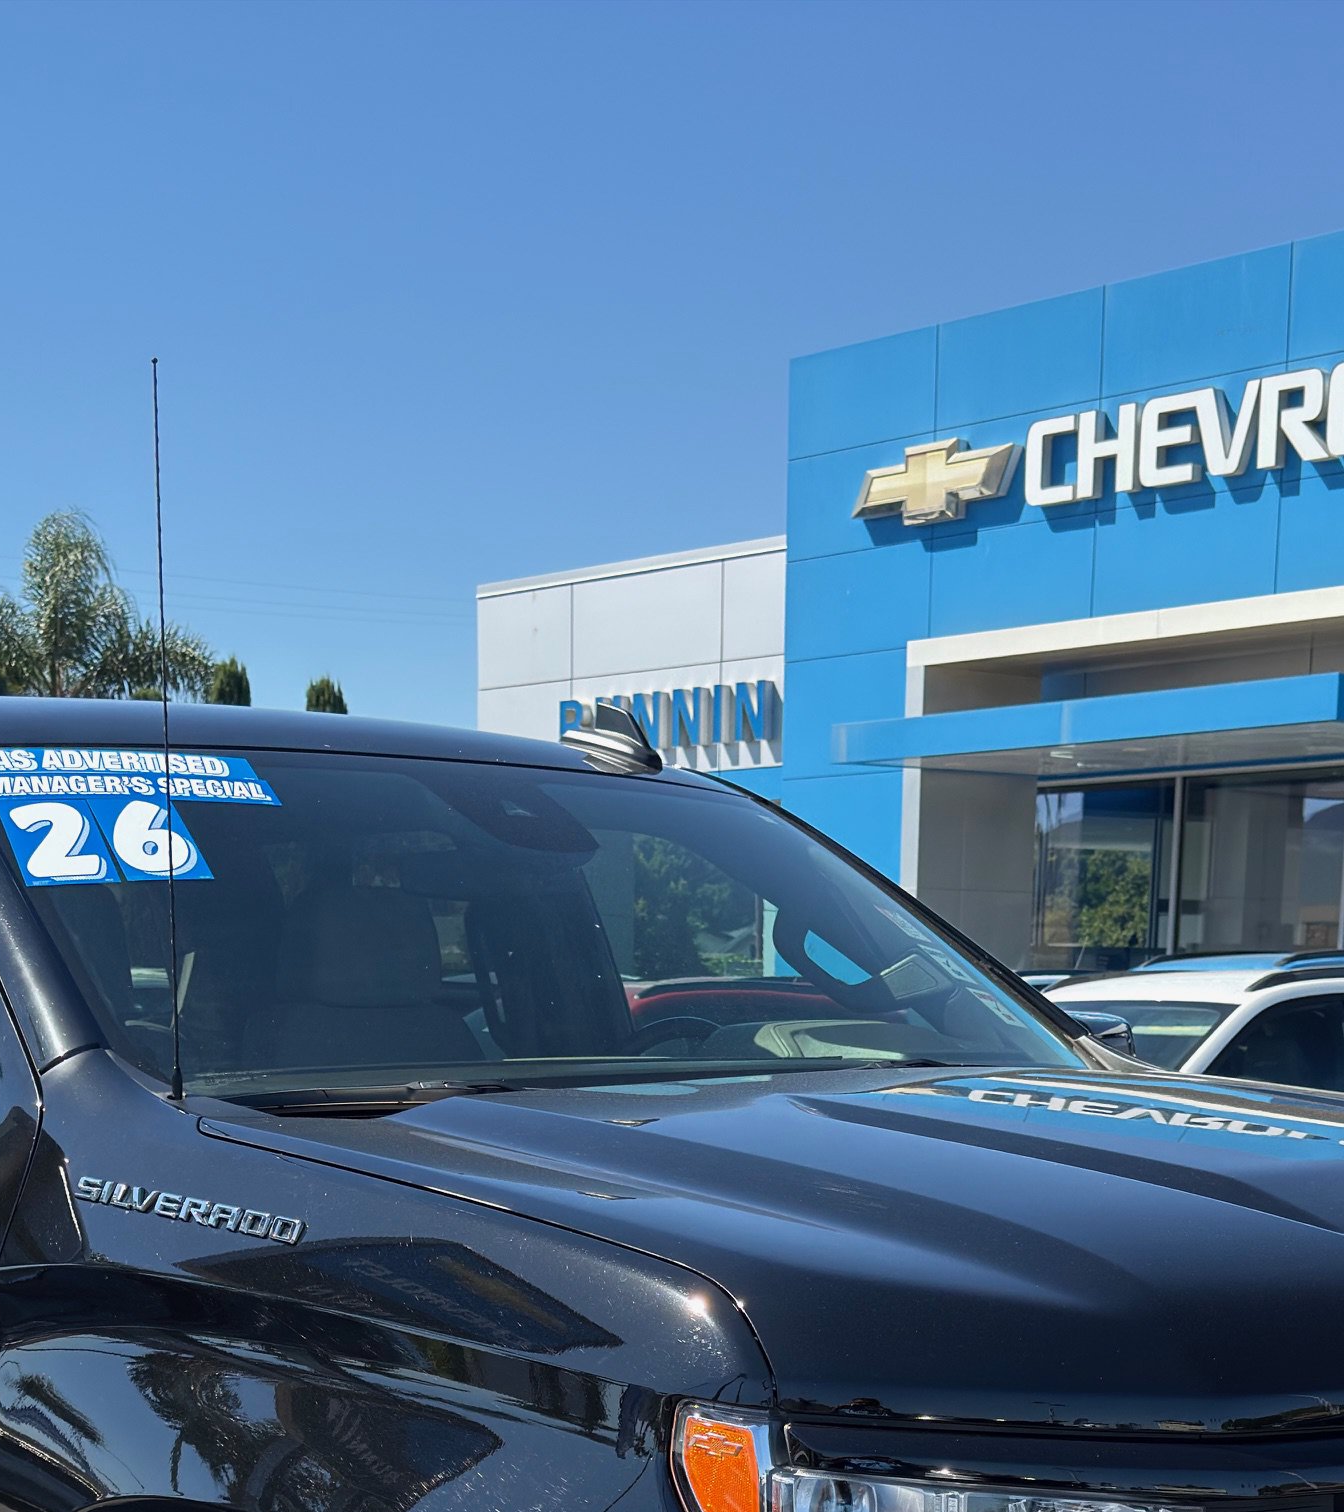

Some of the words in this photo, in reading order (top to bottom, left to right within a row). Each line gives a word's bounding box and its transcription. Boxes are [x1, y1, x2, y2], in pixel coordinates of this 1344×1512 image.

[559, 680, 775, 750] BNNIN
[42, 750, 230, 777] ADVERTISED
[158, 777, 272, 801] SPECIAL
[74, 1176, 307, 1245] SILVERADO
